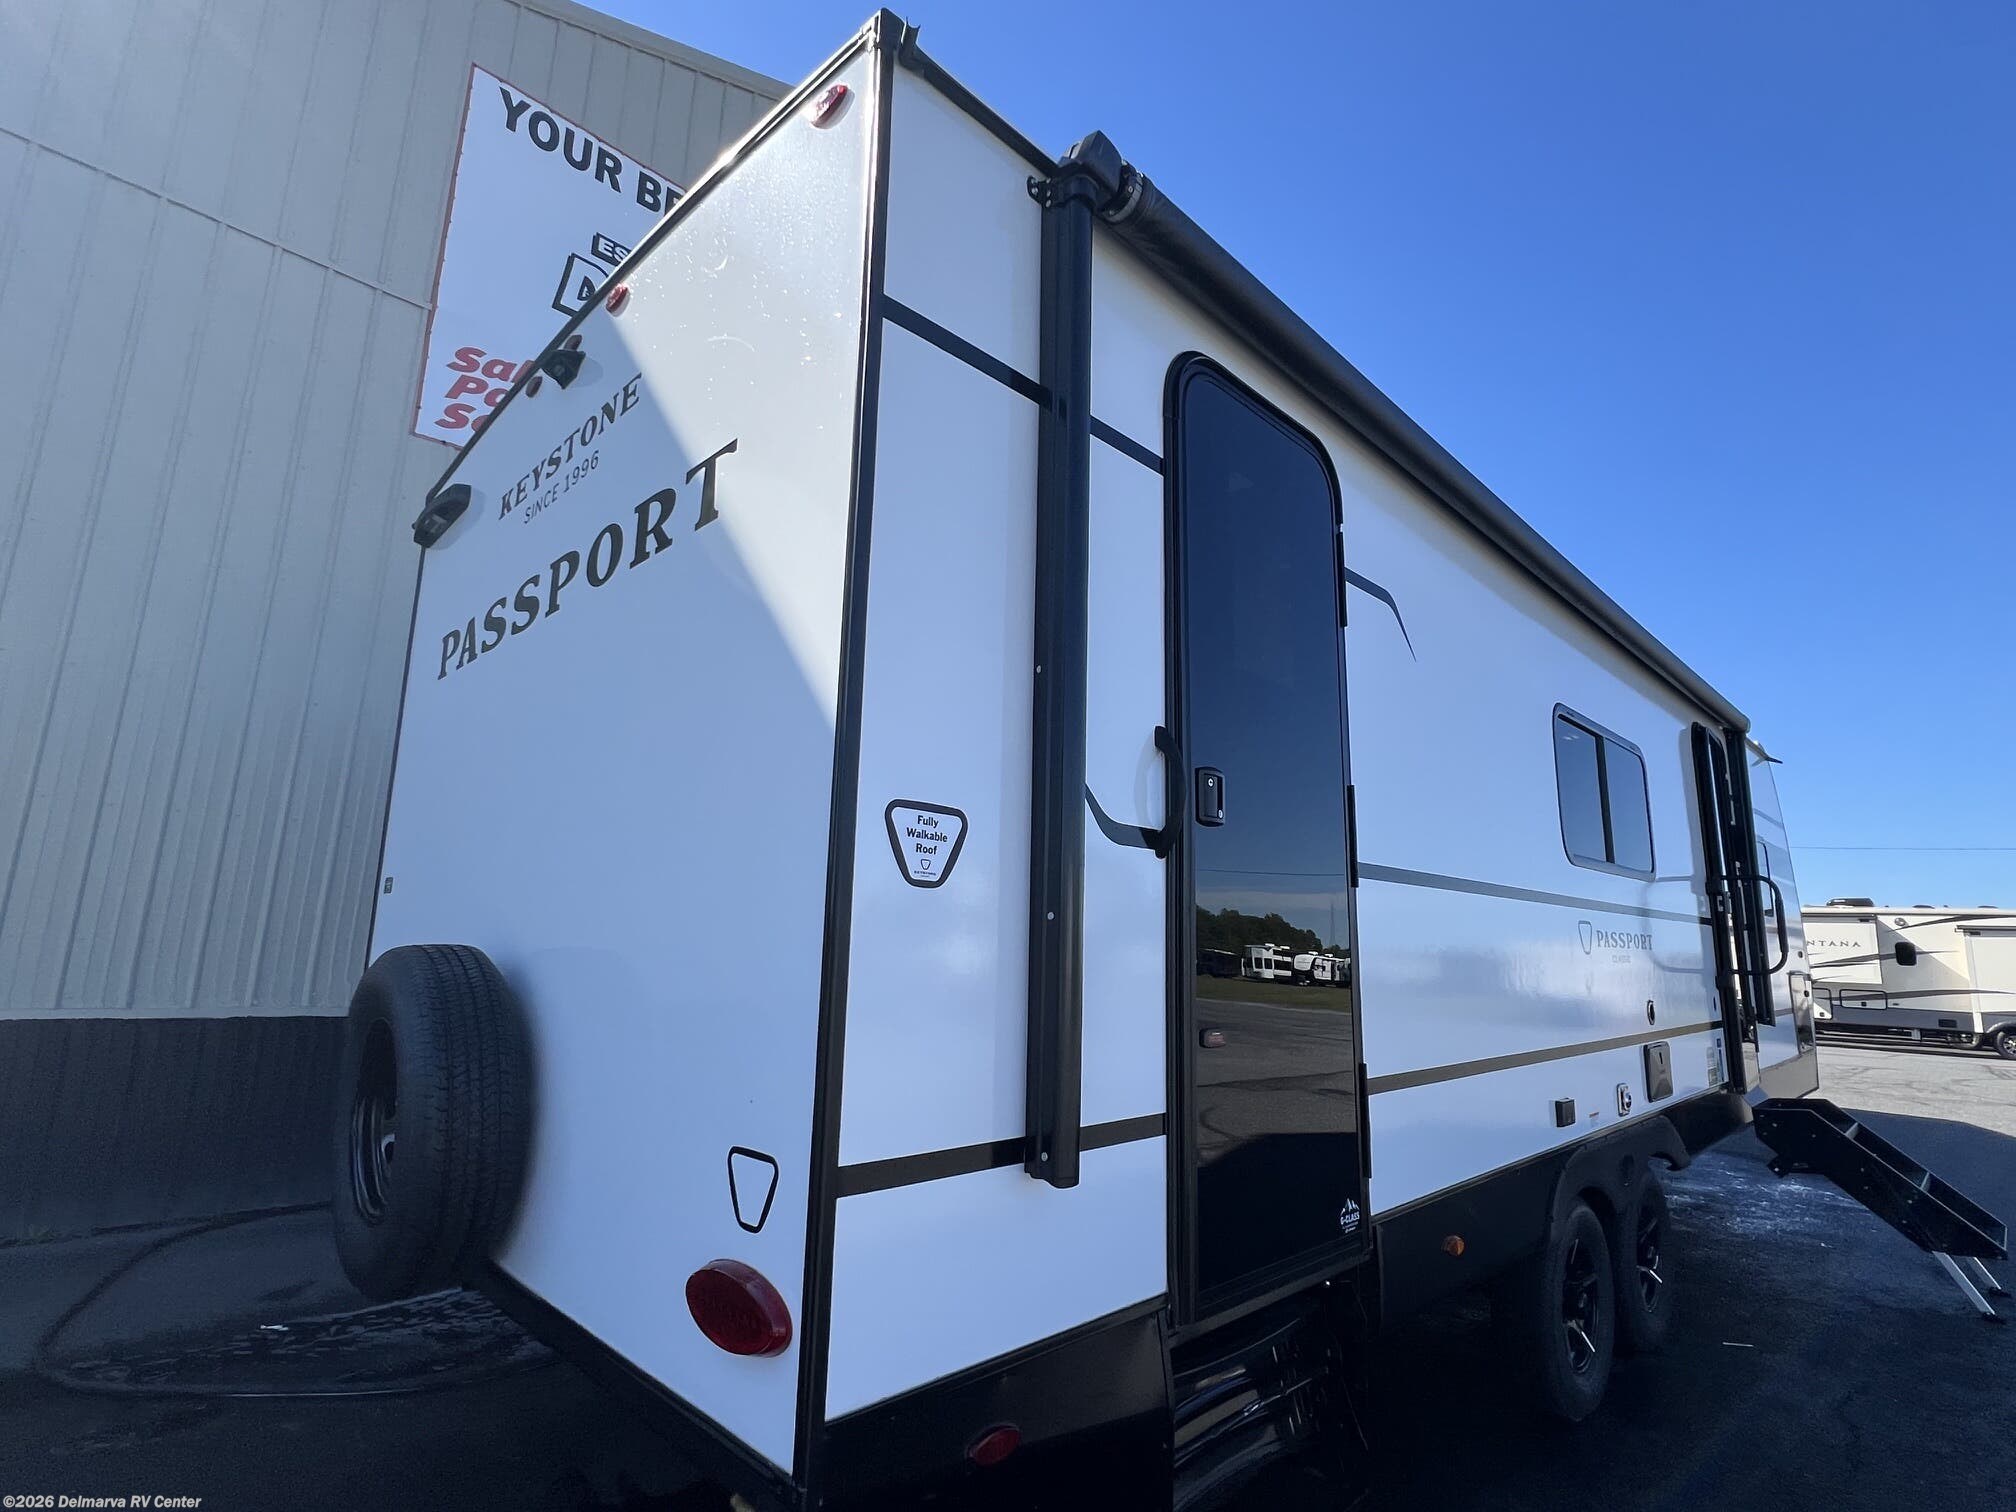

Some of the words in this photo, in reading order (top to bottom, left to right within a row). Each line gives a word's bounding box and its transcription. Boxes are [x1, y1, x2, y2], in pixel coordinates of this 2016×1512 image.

[499, 86, 622, 193] YOUR
[498, 372, 642, 520] KEYSTONE
[523, 482, 560, 524] SINCE
[563, 450, 600, 493] 1996
[437, 437, 739, 681] PASSPORT
[906, 827, 948, 843] Walkable
[917, 815, 939, 829] Fully
[915, 842, 938, 855] Roof
[1596, 930, 1653, 950] PASSPORT
